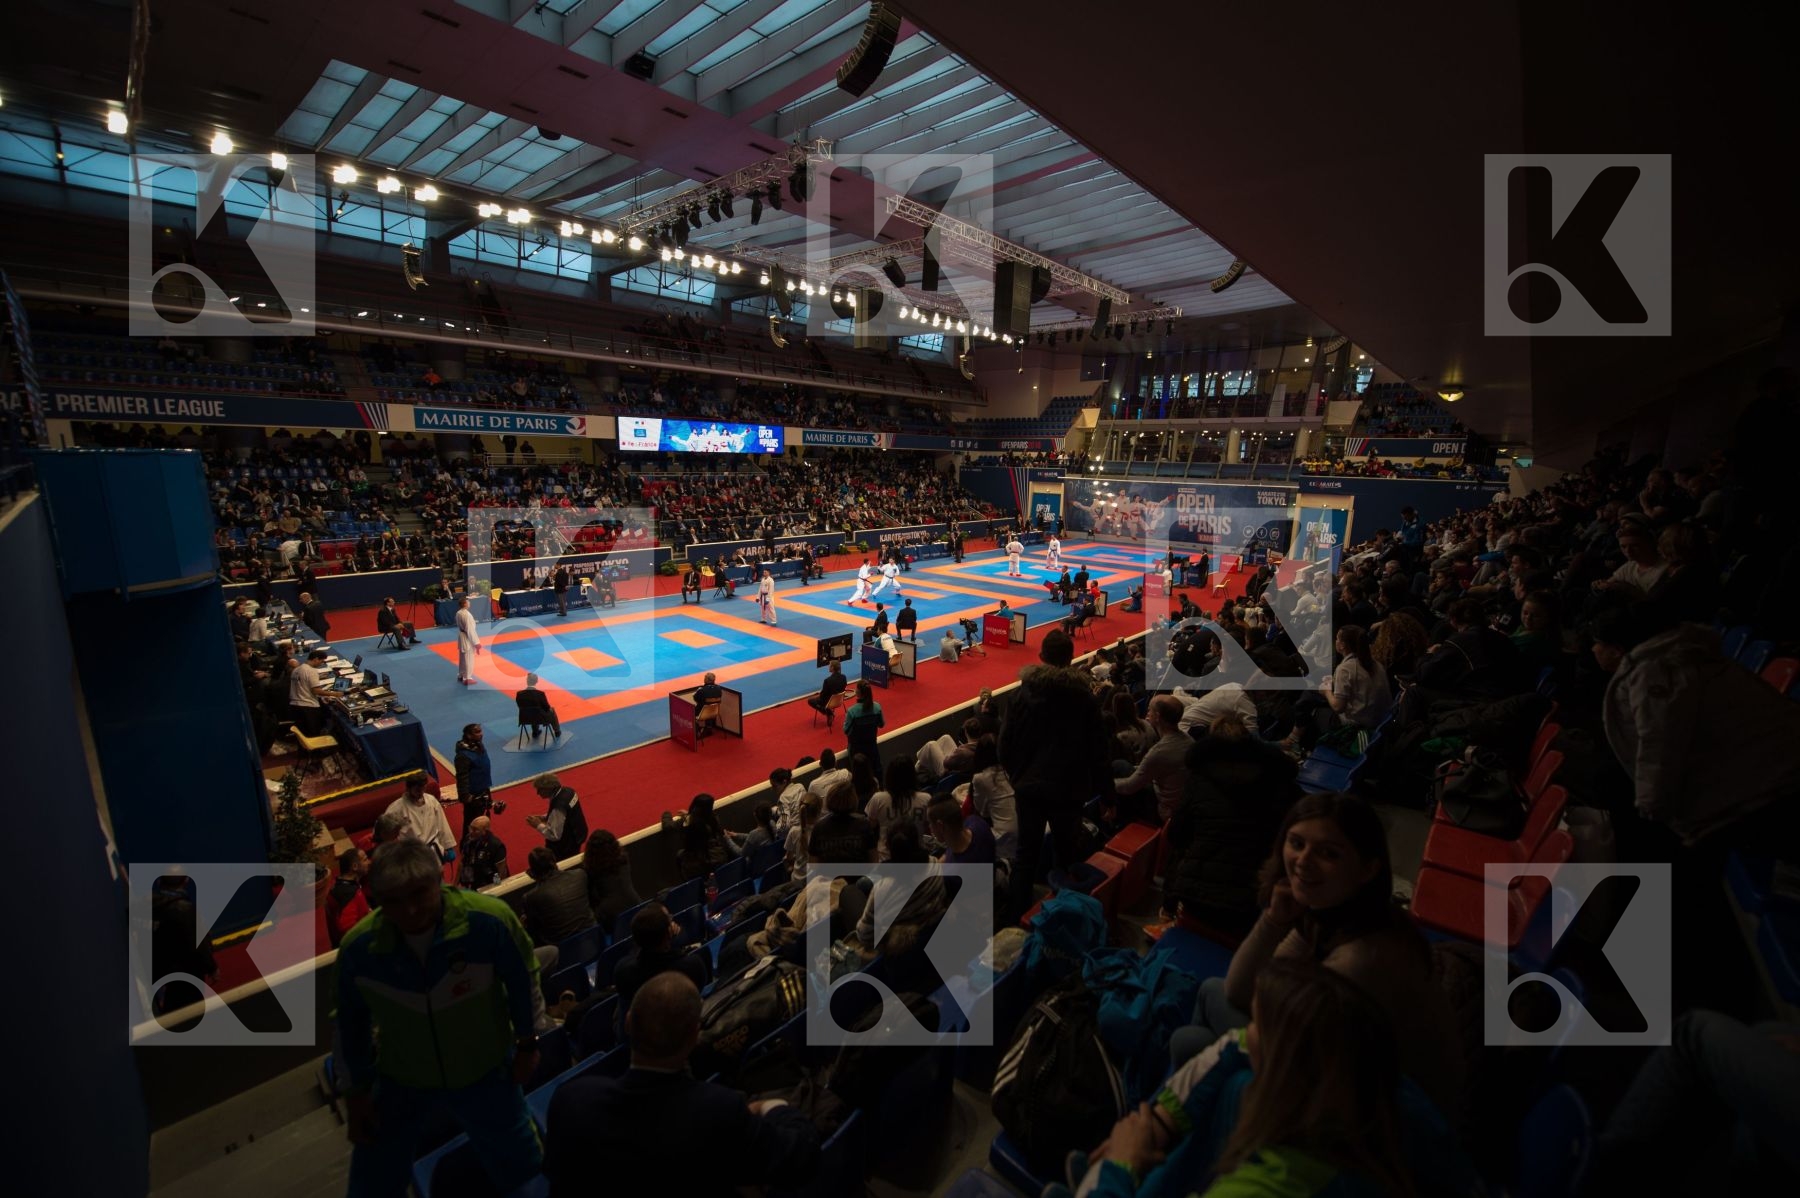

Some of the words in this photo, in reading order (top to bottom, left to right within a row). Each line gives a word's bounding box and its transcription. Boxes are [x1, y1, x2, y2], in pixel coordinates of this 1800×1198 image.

[0, 391, 51, 411] RAE
[55, 393, 149, 415] PREMIER
[153, 398, 226, 417] LEAGUE
[422, 412, 484, 428] MAIRIE
[490, 415, 511, 429] DE
[516, 417, 558, 431] PARIS
[805, 432, 833, 443] MAIRIE
[836, 434, 847, 443] DE
[848, 434, 868, 444] PARIS
[1433, 442, 1459, 454] OPEN
[1176, 493, 1215, 514] OPEN
[1257, 496, 1285, 506] TOKYO
[1178, 515, 1189, 526] DE
[1189, 514, 1231, 536] PARIS
